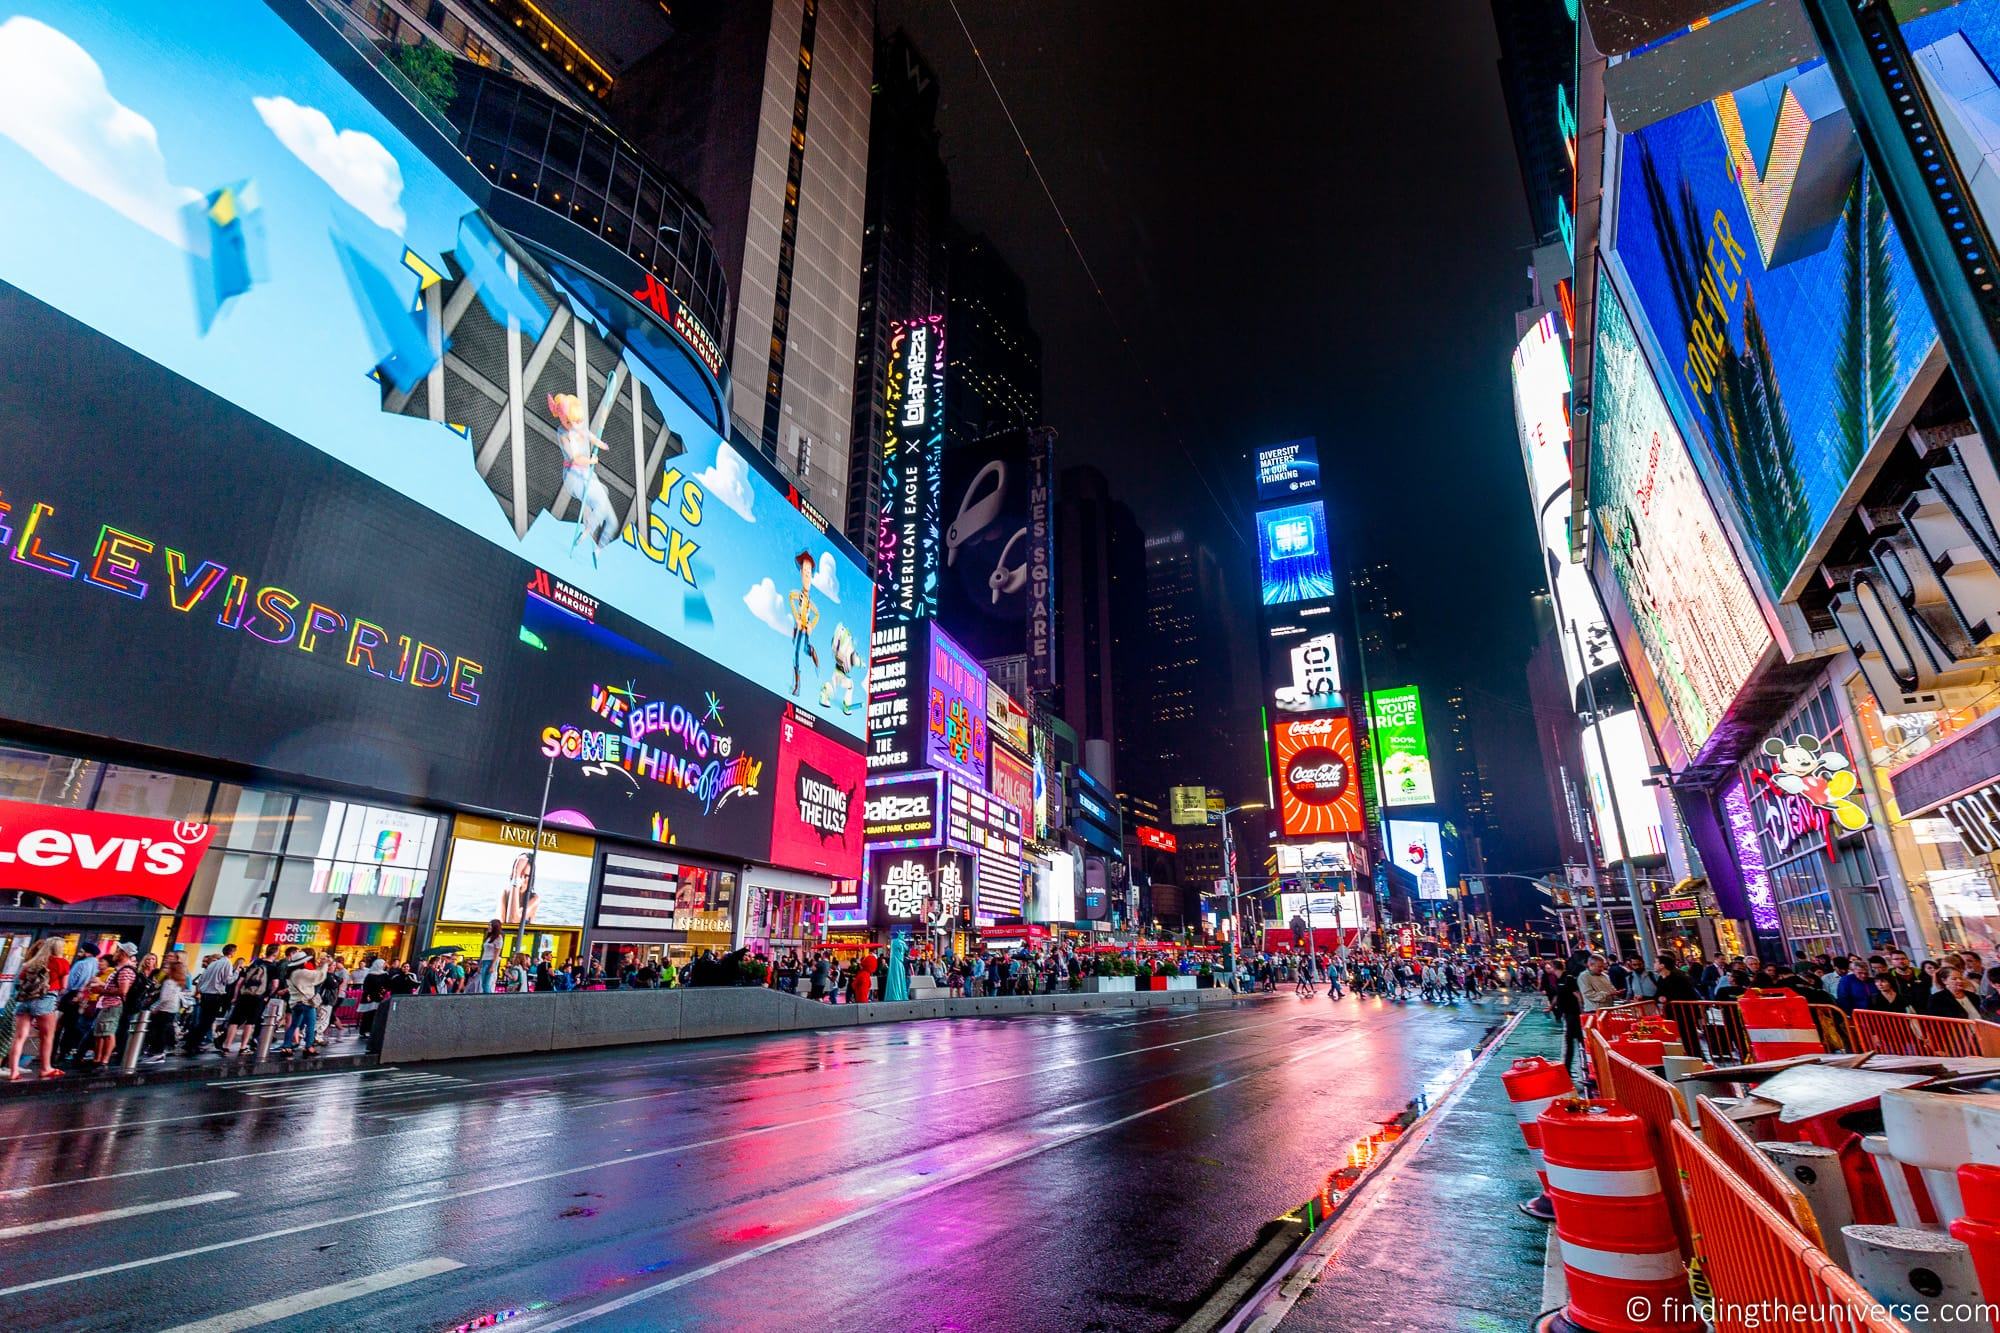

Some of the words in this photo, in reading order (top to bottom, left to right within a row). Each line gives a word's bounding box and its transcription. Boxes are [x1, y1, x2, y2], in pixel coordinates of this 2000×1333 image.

[1683, 209, 1746, 415] FOREVER
[676, 318, 719, 376] MARQUIS
[677, 304, 723, 368] MARRIOTT
[1259, 445, 1300, 460] DIVERSITY
[1260, 454, 1295, 468] MATTERS
[1261, 467, 1271, 476] IN
[1271, 463, 1288, 474] OUR
[1262, 470, 1299, 484] THINKING
[904, 465, 919, 517] EAGLE
[1031, 454, 1047, 537] TIMES
[900, 526, 916, 611] AMERICAN
[554, 591, 595, 618] MARQUIS
[556, 581, 600, 609] MARRIOTT
[1032, 546, 1048, 657] SQUARE
[1378, 701, 1417, 715] YOUR
[627, 701, 710, 759] BELONG
[868, 714, 908, 731] ILØTS
[1375, 711, 1417, 729] RICE
[876, 738, 893, 754] THE
[1390, 736, 1417, 744] 100%
[541, 723, 702, 795] SOMETHING
[866, 751, 909, 769] TROKES
[801, 776, 847, 813] VISITING
[799, 799, 822, 828] THE
[822, 806, 846, 834] U.S.?
[866, 825, 886, 835] GRANT
[903, 821, 932, 832] CHICAGO
[285, 923, 321, 933] PROUD
[680, 917, 731, 932] SEPHORA
